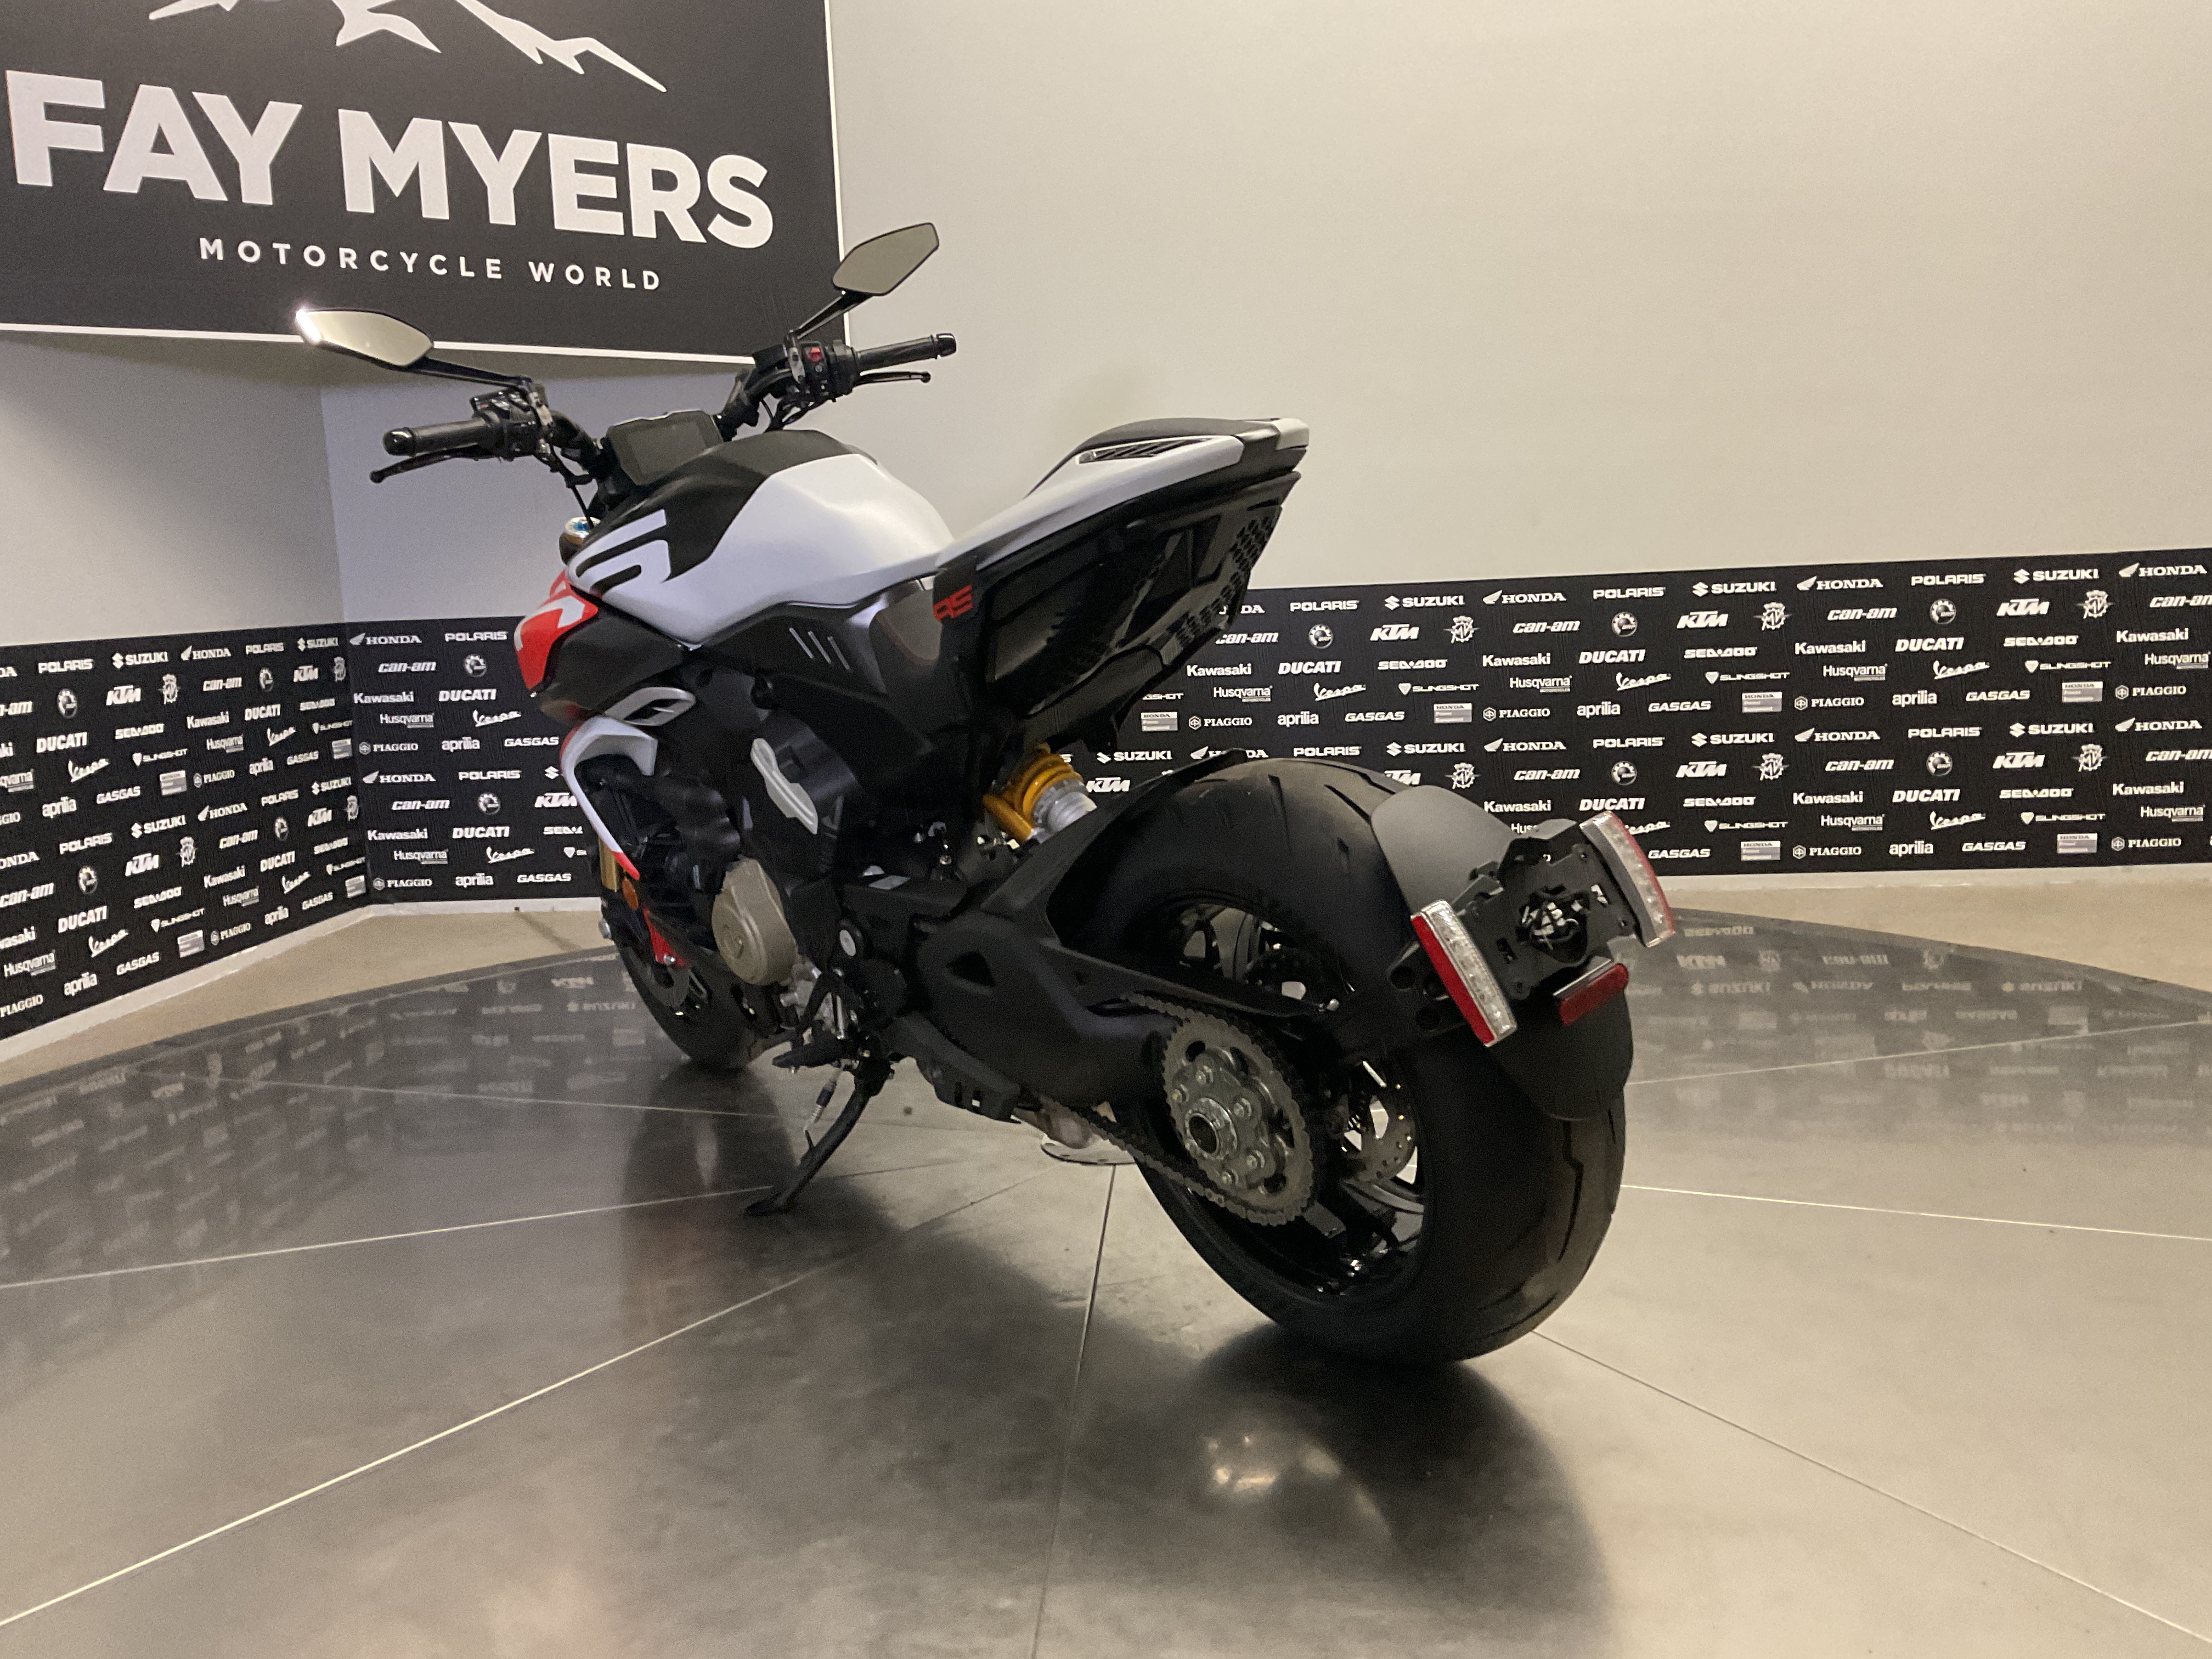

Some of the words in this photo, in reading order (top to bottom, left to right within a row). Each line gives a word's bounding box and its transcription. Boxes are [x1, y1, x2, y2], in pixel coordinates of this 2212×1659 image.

[5, 69, 302, 205] FAY
[338, 109, 774, 249] MYERS
[200, 237, 503, 280] MOTORCYCLE
[529, 262, 660, 290] WORLD
[2033, 569, 2099, 581] SUZUKI
[2140, 565, 2207, 577] HONDA
[1817, 579, 1883, 590] HONDA
[1911, 574, 1986, 585] POLARIS
[1593, 587, 1666, 599] POLARIS
[1711, 582, 1776, 594] SUZUKI
[1402, 595, 1465, 607] SUZUKI
[1502, 592, 1566, 603] HONDA
[1290, 600, 1359, 612] POLARIS
[1996, 599, 2050, 616] KTM
[1677, 611, 1728, 628] KTM
[1827, 608, 1897, 620] can-am
[1370, 624, 1419, 641] KTM
[1513, 621, 1580, 633] can-am
[365, 635, 422, 645] HONDA
[445, 631, 507, 641] POLARIS
[2117, 628, 2188, 642] Kawasaki
[246, 642, 284, 654] POLARIS
[307, 637, 338, 648] SUZUKI
[1795, 640, 1866, 654] Kawasaki
[1895, 637, 1964, 652] DUCATI
[125, 652, 168, 665] SUZUKI
[193, 648, 231, 659] HONDA
[1579, 650, 1645, 664] DUCATI
[2145, 653, 2208, 665] Husqvarna
[1483, 653, 1550, 667] Kawasaki
[2040, 662, 2111, 670] SLINGSHOT
[38, 659, 93, 674] POLARIS
[378, 662, 436, 673] can-am
[1187, 663, 1251, 676] Kawasaki
[1278, 661, 1341, 674] DUCATI
[1824, 665, 1885, 677] Husqvarna
[1933, 661, 1990, 679] Vespa
[1510, 675, 1570, 689] Husqvarna
[1616, 672, 1671, 691] Vespa
[1720, 672, 1790, 681] SLINGSHOT
[106, 685, 141, 706] KTM
[354, 691, 414, 703] Kawasaki
[439, 689, 496, 702] DUCATI
[1214, 686, 1271, 698] Husqvarna
[1314, 683, 1366, 701] Vespa
[1966, 690, 2030, 701] GASGAS
[2132, 686, 2186, 696] PIAGGIO
[1812, 697, 1864, 707] PIAGGIO
[1892, 690, 1937, 707] aprilia
[245, 704, 280, 721] DUCATI
[1577, 701, 1620, 718] aprilia
[1649, 701, 1711, 712] GASGAS
[380, 713, 433, 724] Husqvarna
[473, 710, 521, 727] Vespa
[1278, 711, 1319, 727] aprilia
[1345, 712, 1404, 721] GASGAS
[1499, 708, 1550, 718] PIAGGIO
[187, 711, 229, 729] Kawasaki
[1204, 718, 1252, 726] PIAGGIO
[2135, 720, 2202, 731] HONDA
[1908, 727, 1982, 738] POLARIS
[2028, 723, 2093, 735] SUZUKI
[504, 737, 559, 747] GASGAS
[1710, 733, 1774, 744] SUZUKI
[1814, 731, 1880, 741] HONDA
[37, 732, 87, 753] DUCATI
[373, 743, 418, 752] PIAGGIO
[442, 737, 480, 752] aprilia
[1404, 743, 1465, 754] SUZUKI
[1503, 738, 1566, 751] HONDA
[1593, 737, 1664, 748] POLARIS
[1114, 751, 1172, 761] SUZUKI
[1294, 746, 1361, 757] POLARIS
[1825, 760, 1894, 771] can-am
[1993, 752, 2045, 769] KTM
[459, 770, 522, 780] POLARIS
[1514, 769, 1580, 780] can-am
[1676, 761, 1727, 777] KTM
[204, 770, 235, 783] PIAGGIO
[379, 774, 436, 783] HONDA
[1385, 770, 1421, 786] TM
[321, 777, 351, 791] SUZUKI
[1086, 777, 1130, 792] KTM
[2113, 781, 2184, 795] Kawasaki
[97, 786, 140, 804] GASGAS
[1793, 791, 1863, 804] Kawasaki
[1892, 789, 1960, 802] DUCATI
[42, 796, 77, 819] aprilia
[392, 800, 450, 810] can-am
[1484, 800, 1551, 812] Kawasaki
[1580, 798, 1645, 810] DUCATI
[210, 803, 247, 819] HONDA
[2141, 806, 2203, 818] Husqvarna
[144, 815, 186, 833] SUZUKI
[1821, 815, 1882, 827] Husqvarna
[1930, 811, 1985, 830] Vespa
[453, 826, 510, 838] DUCATI
[1625, 821, 1670, 834] espa
[368, 828, 428, 840] Kawasaki
[59, 833, 112, 854] POLARIS
[1889, 840, 1933, 857] aprilia
[1962, 842, 2026, 851] GASGAS
[2128, 838, 2181, 848] PIAGGIO
[394, 849, 448, 860] Husqvarna
[487, 847, 534, 864] Vespa
[1648, 849, 1711, 859] GASGAS
[1809, 847, 1861, 856] PIAGGIO
[0, 851, 40, 869] ONDA
[125, 853, 159, 877] KTM
[261, 851, 295, 872] DUCATI
[387, 879, 432, 887] PIAGGIO
[455, 873, 493, 888] aprilia
[517, 873, 571, 883] GASGAS
[0, 883, 54, 907] can-am
[58, 906, 107, 933] DUCATI
[117, 952, 159, 975] GASGAS
[64, 972, 97, 996] aprilia
[0, 994, 43, 1017] PIAGGIO
